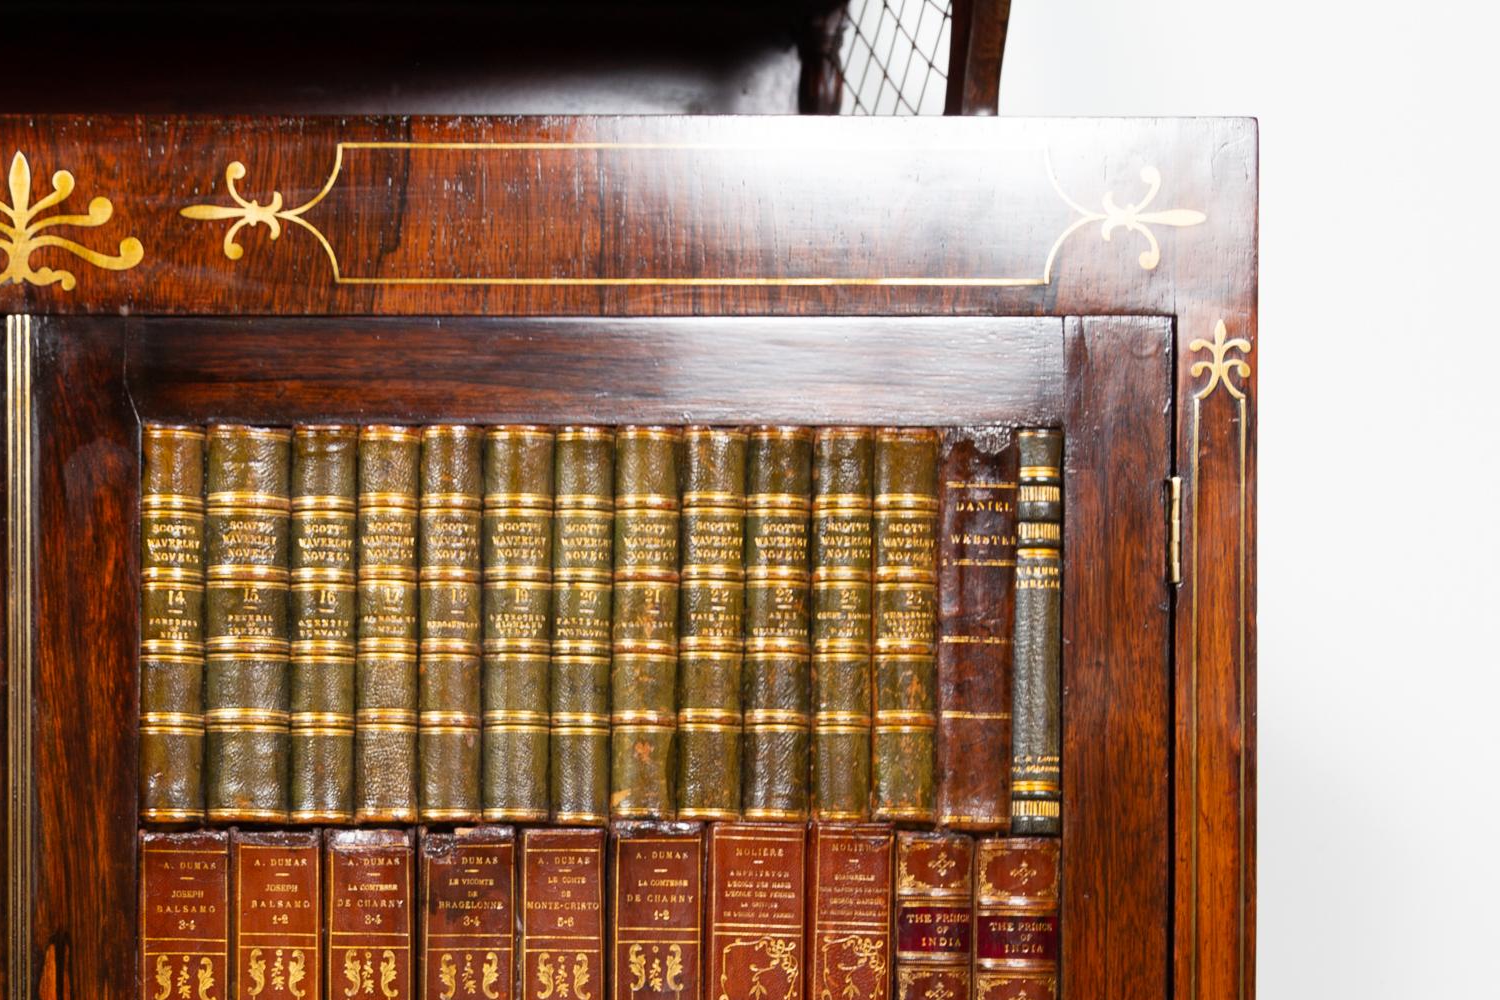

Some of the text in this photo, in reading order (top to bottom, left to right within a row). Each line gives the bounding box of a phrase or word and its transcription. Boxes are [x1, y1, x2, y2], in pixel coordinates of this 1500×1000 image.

[270, 858, 308, 867] DUMAS
[363, 858, 401, 867] DUMAS
[461, 857, 499, 865] DUMAS
[554, 857, 591, 865] DUMAS
[265, 885, 298, 893] JOSEPH
[347, 884, 358, 892] LA
[252, 900, 311, 909] BALSAMO
[357, 900, 404, 909] CHARNY
[438, 901, 504, 910] BRAGELONNE
[906, 914, 933, 924] THE
[936, 926, 949, 934] OF
[989, 922, 1014, 932] THE
[921, 937, 961, 947] INDIA
[1021, 934, 1033, 942] OF
[1005, 944, 1044, 954] INDIA
